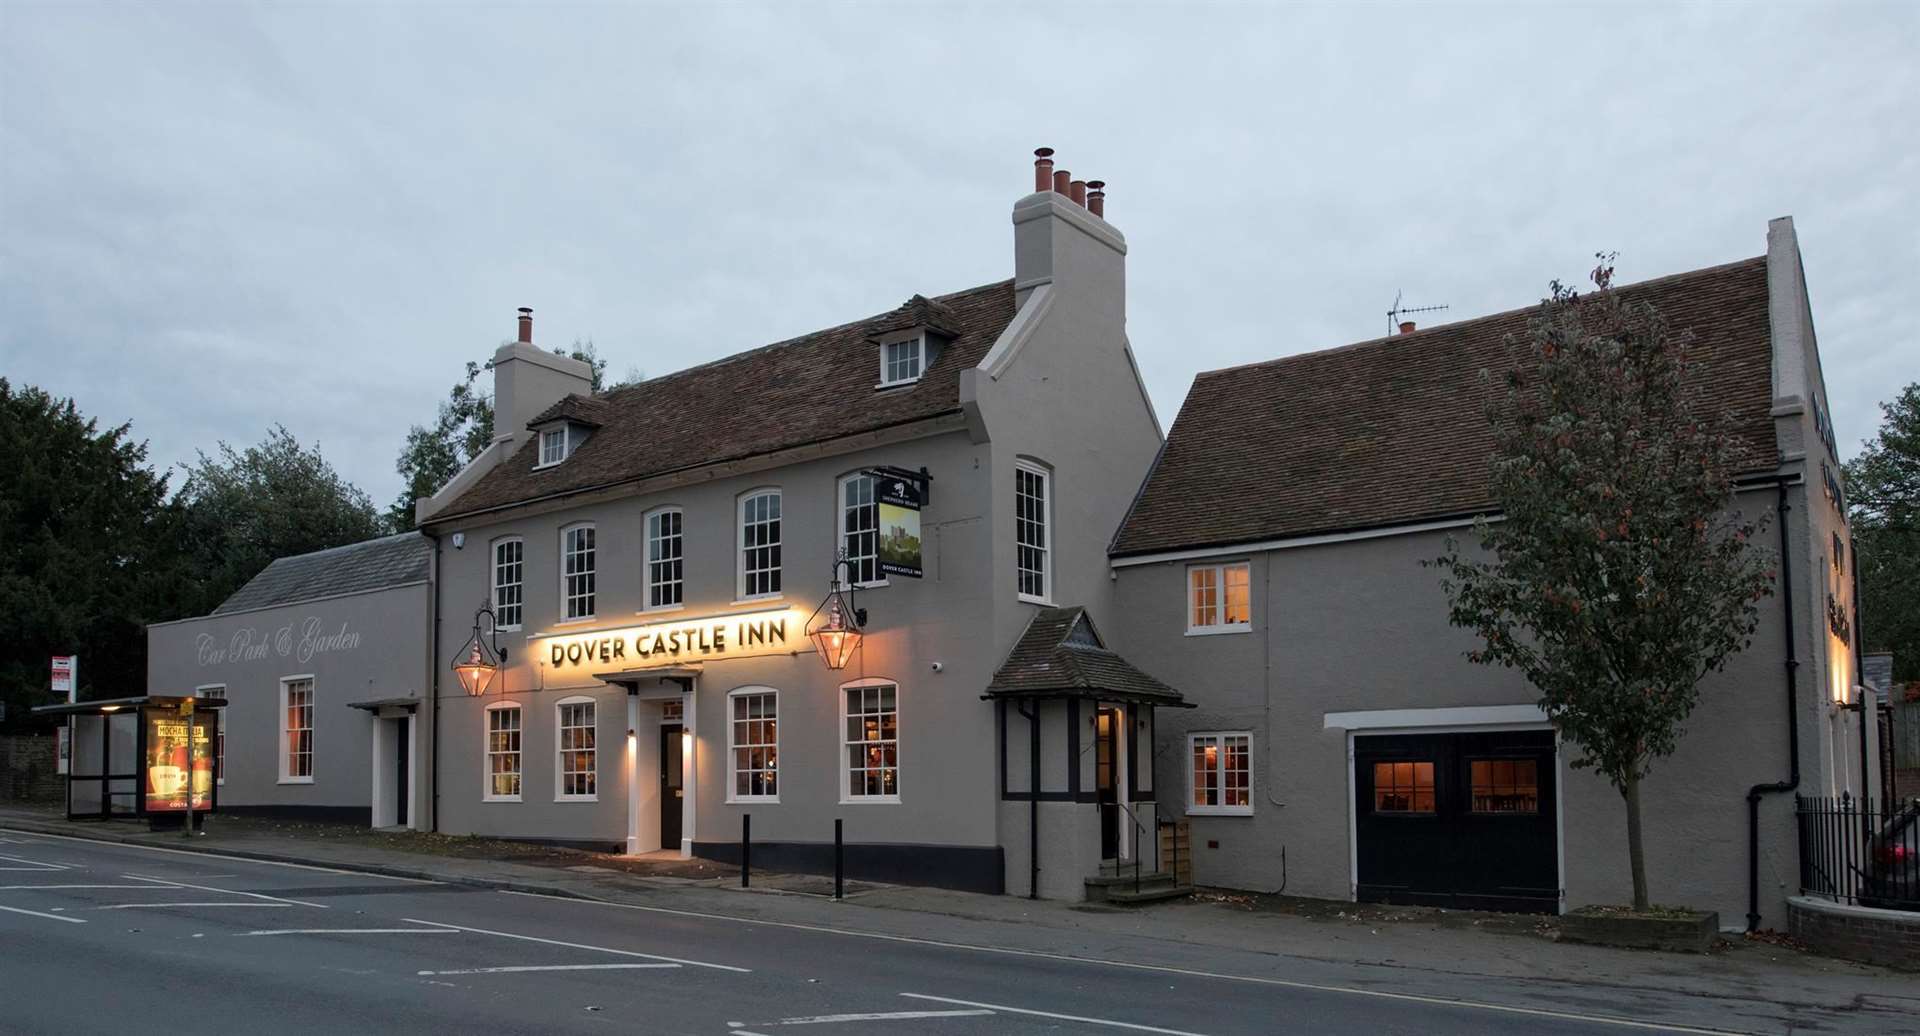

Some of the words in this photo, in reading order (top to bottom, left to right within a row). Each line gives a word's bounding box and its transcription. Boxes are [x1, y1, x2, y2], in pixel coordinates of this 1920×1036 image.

[195, 632, 226, 666] Car
[228, 628, 269, 663] Park
[275, 623, 294, 657] &
[297, 616, 361, 664] Garden
[551, 638, 625, 666] DOVER
[635, 625, 725, 656] CASTLE
[738, 618, 786, 646] INN
[160, 726, 182, 736] MOCHA
[183, 726, 202, 736] ITLIA
